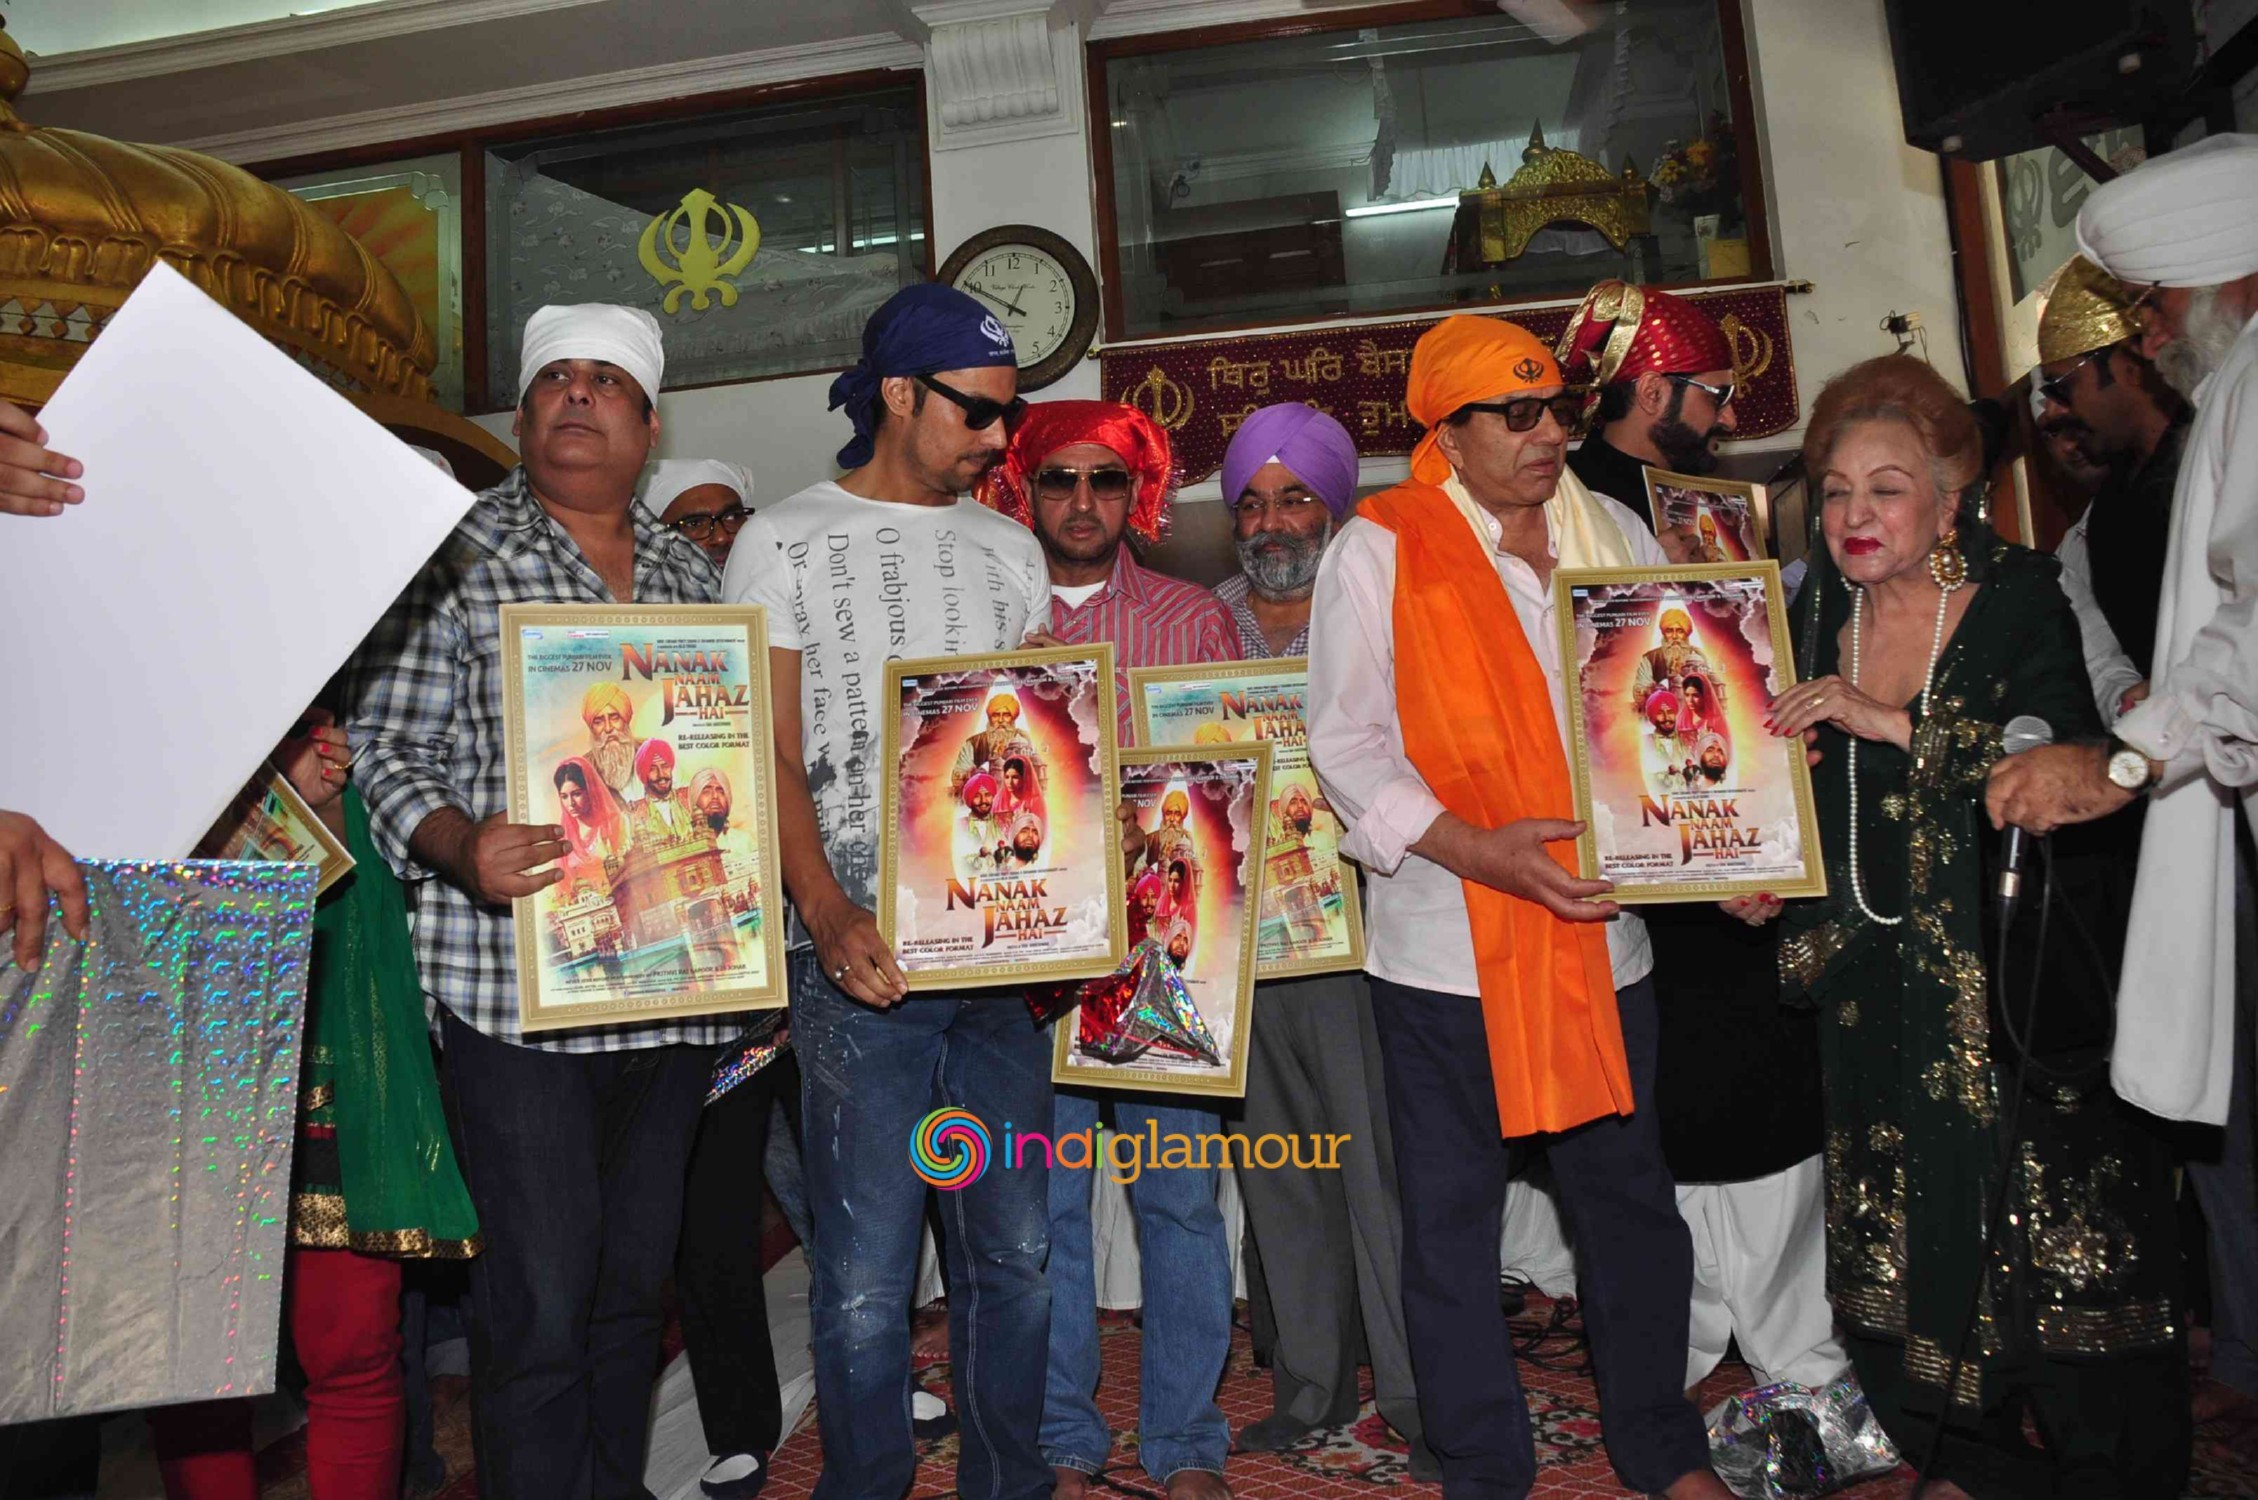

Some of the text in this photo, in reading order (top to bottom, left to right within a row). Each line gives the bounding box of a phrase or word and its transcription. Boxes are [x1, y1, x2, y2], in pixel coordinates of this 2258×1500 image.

[984, 264, 995, 277] 11
[1008, 257, 1020, 270] 12
[1035, 263, 1039, 275] 1
[1050, 280, 1057, 292] 2
[1055, 302, 1062, 314] 3
[1047, 325, 1055, 337] 4
[1032, 342, 1039, 354] 5
[1355, 339, 1408, 378] ਬੈਸ
[1358, 400, 1408, 435] ਤੁਮ
[876, 527, 900, 545] O
[788, 542, 809, 570] Or
[934, 529, 956, 578] Stop
[827, 533, 850, 590] Don't
[879, 552, 910, 648] frabjous
[833, 598, 858, 644] sew
[992, 599, 1007, 633] his
[1615, 618, 1627, 627] 27
[1628, 617, 1651, 627] NOV
[619, 643, 728, 681] NANAK
[803, 642, 824, 678] her
[844, 654, 860, 664] a
[538, 665, 570, 673] CINEMAS
[572, 662, 584, 672] 27
[586, 661, 612, 672] NOV
[674, 673, 720, 685] NAAM
[661, 678, 749, 727] JAHAZ
[942, 705, 953, 714] 27
[955, 704, 978, 713] NOV
[1219, 691, 1304, 720] NANAK
[699, 706, 724, 720] HAI
[813, 688, 832, 735] face
[1184, 708, 1193, 716] 27
[1195, 707, 1215, 715] NOV
[1263, 711, 1299, 721] NAAM
[1252, 716, 1306, 740] JAHA
[1283, 737, 1303, 747] HAI
[1137, 799, 1158, 808] NOV
[1638, 794, 1740, 827] NANAK
[848, 794, 871, 833] her
[1690, 817, 1733, 831] NAAM
[1678, 824, 1762, 866] JAHAZ
[1714, 847, 1740, 860] HAI
[945, 877, 1048, 911] NANAK
[996, 900, 1040, 912] NAAM
[982, 906, 1068, 949] JAHAZ
[1018, 928, 1043, 941] HAI
